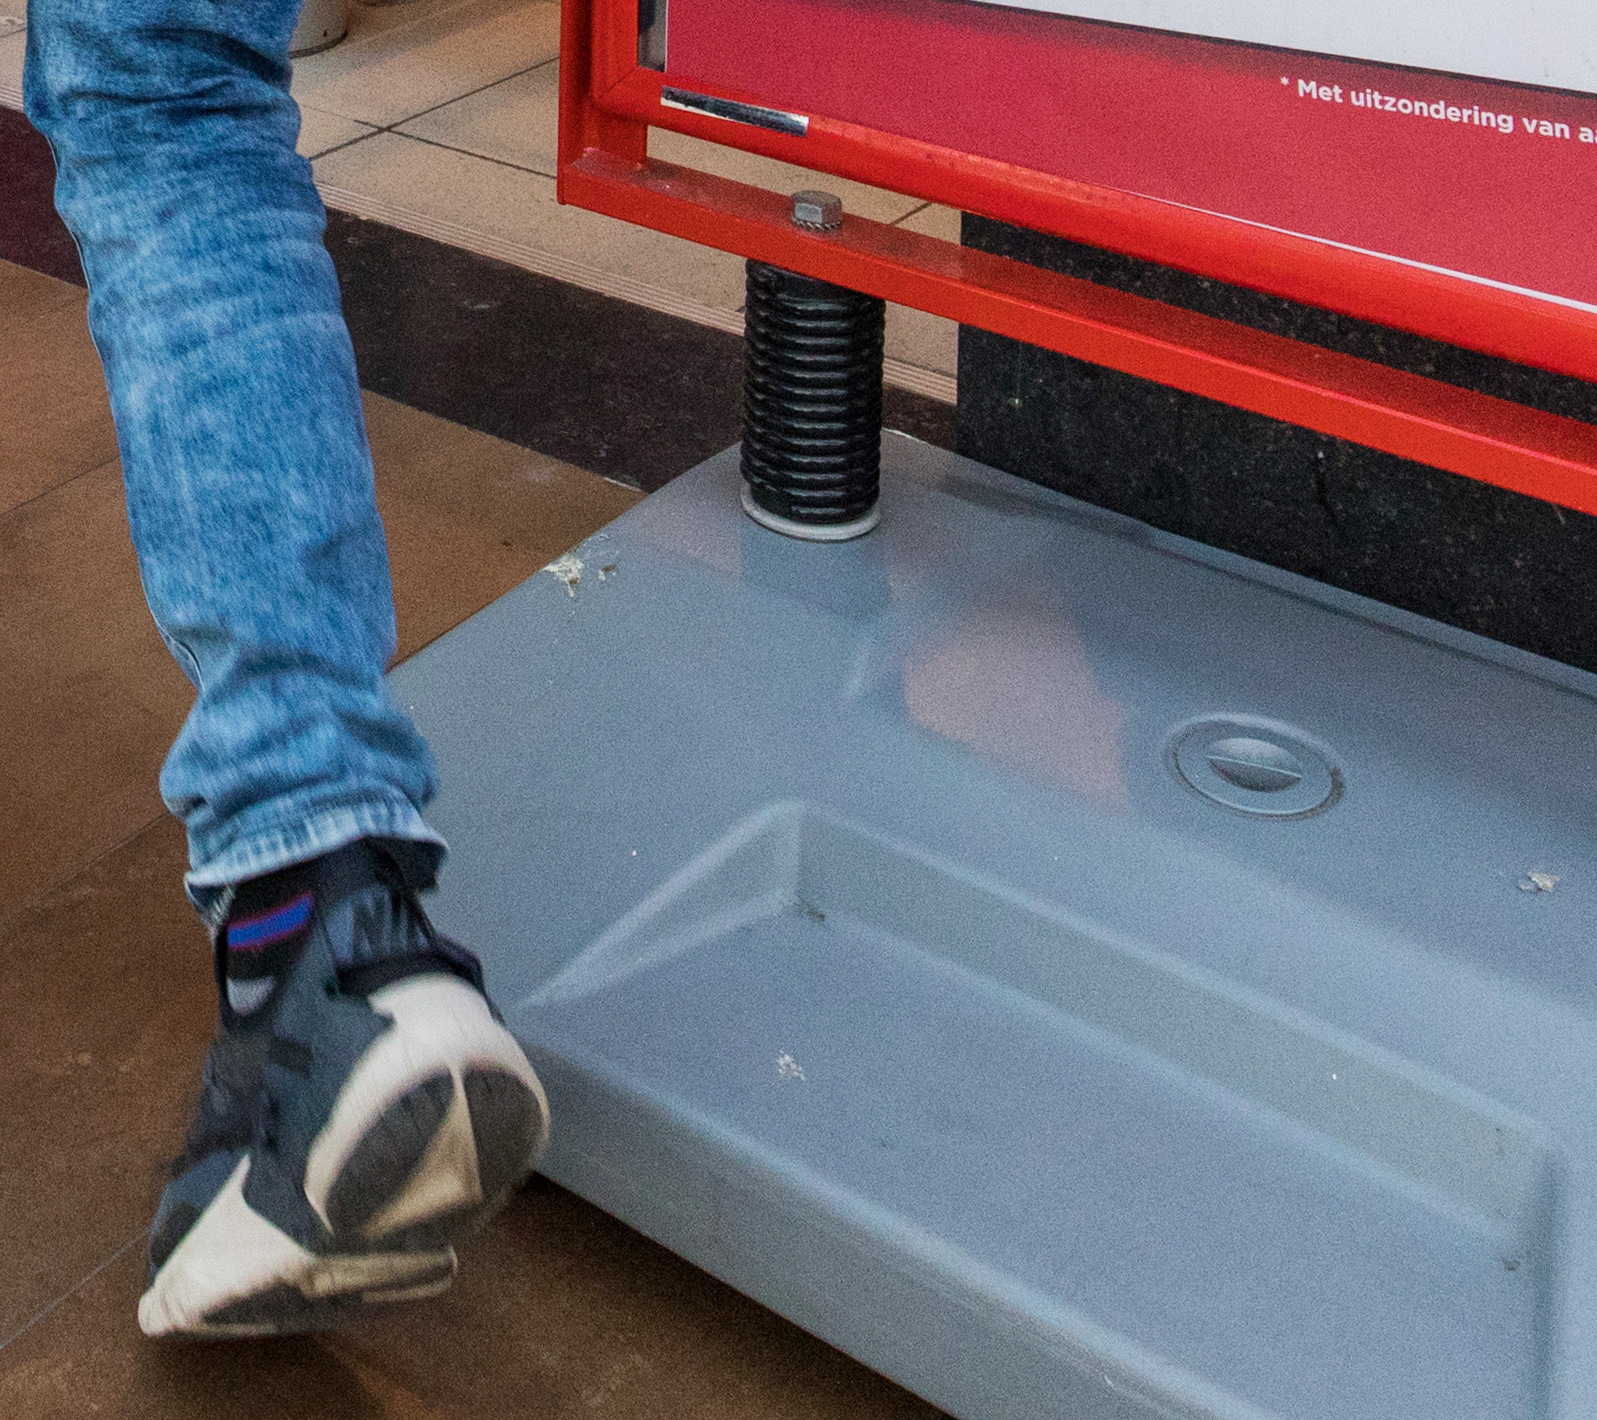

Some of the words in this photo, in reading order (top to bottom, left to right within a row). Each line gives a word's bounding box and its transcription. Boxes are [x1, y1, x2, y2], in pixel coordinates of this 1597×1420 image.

[1297, 78, 1343, 104] Met
[1350, 88, 1515, 133] uitzondering
[1522, 116, 1571, 140] van
